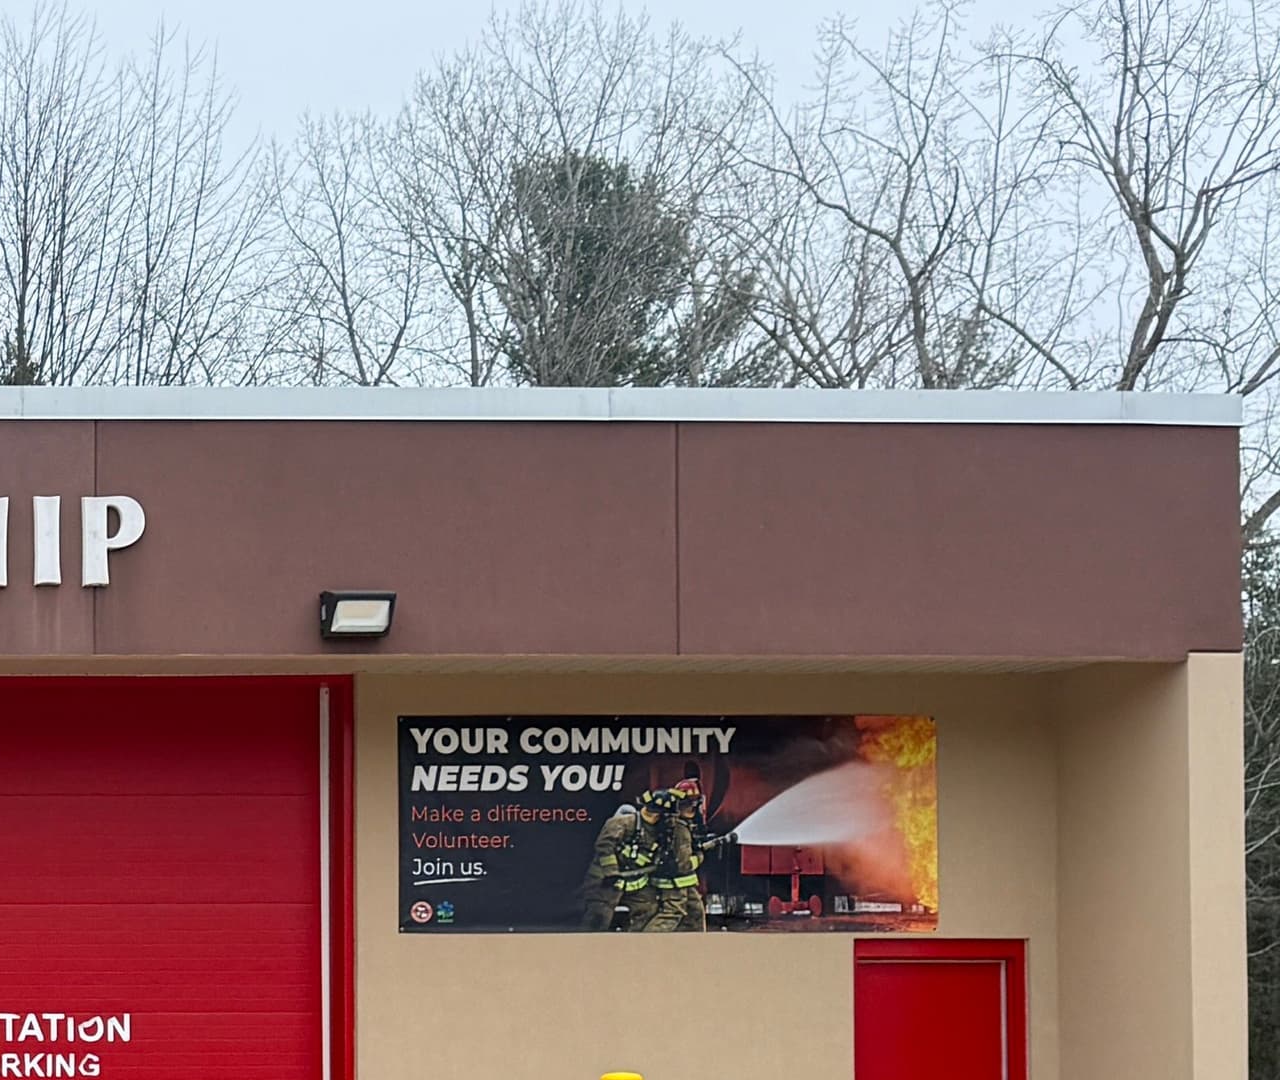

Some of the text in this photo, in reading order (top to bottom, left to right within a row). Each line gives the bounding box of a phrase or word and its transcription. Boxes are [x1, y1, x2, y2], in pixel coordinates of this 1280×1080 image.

[409, 727, 736, 754] YOUR COMMUNITY
[411, 764, 625, 792] NEEDS YOU!
[411, 804, 592, 822] Make a difference.
[412, 831, 514, 849] Volunteer.
[412, 857, 488, 877] Join us.
